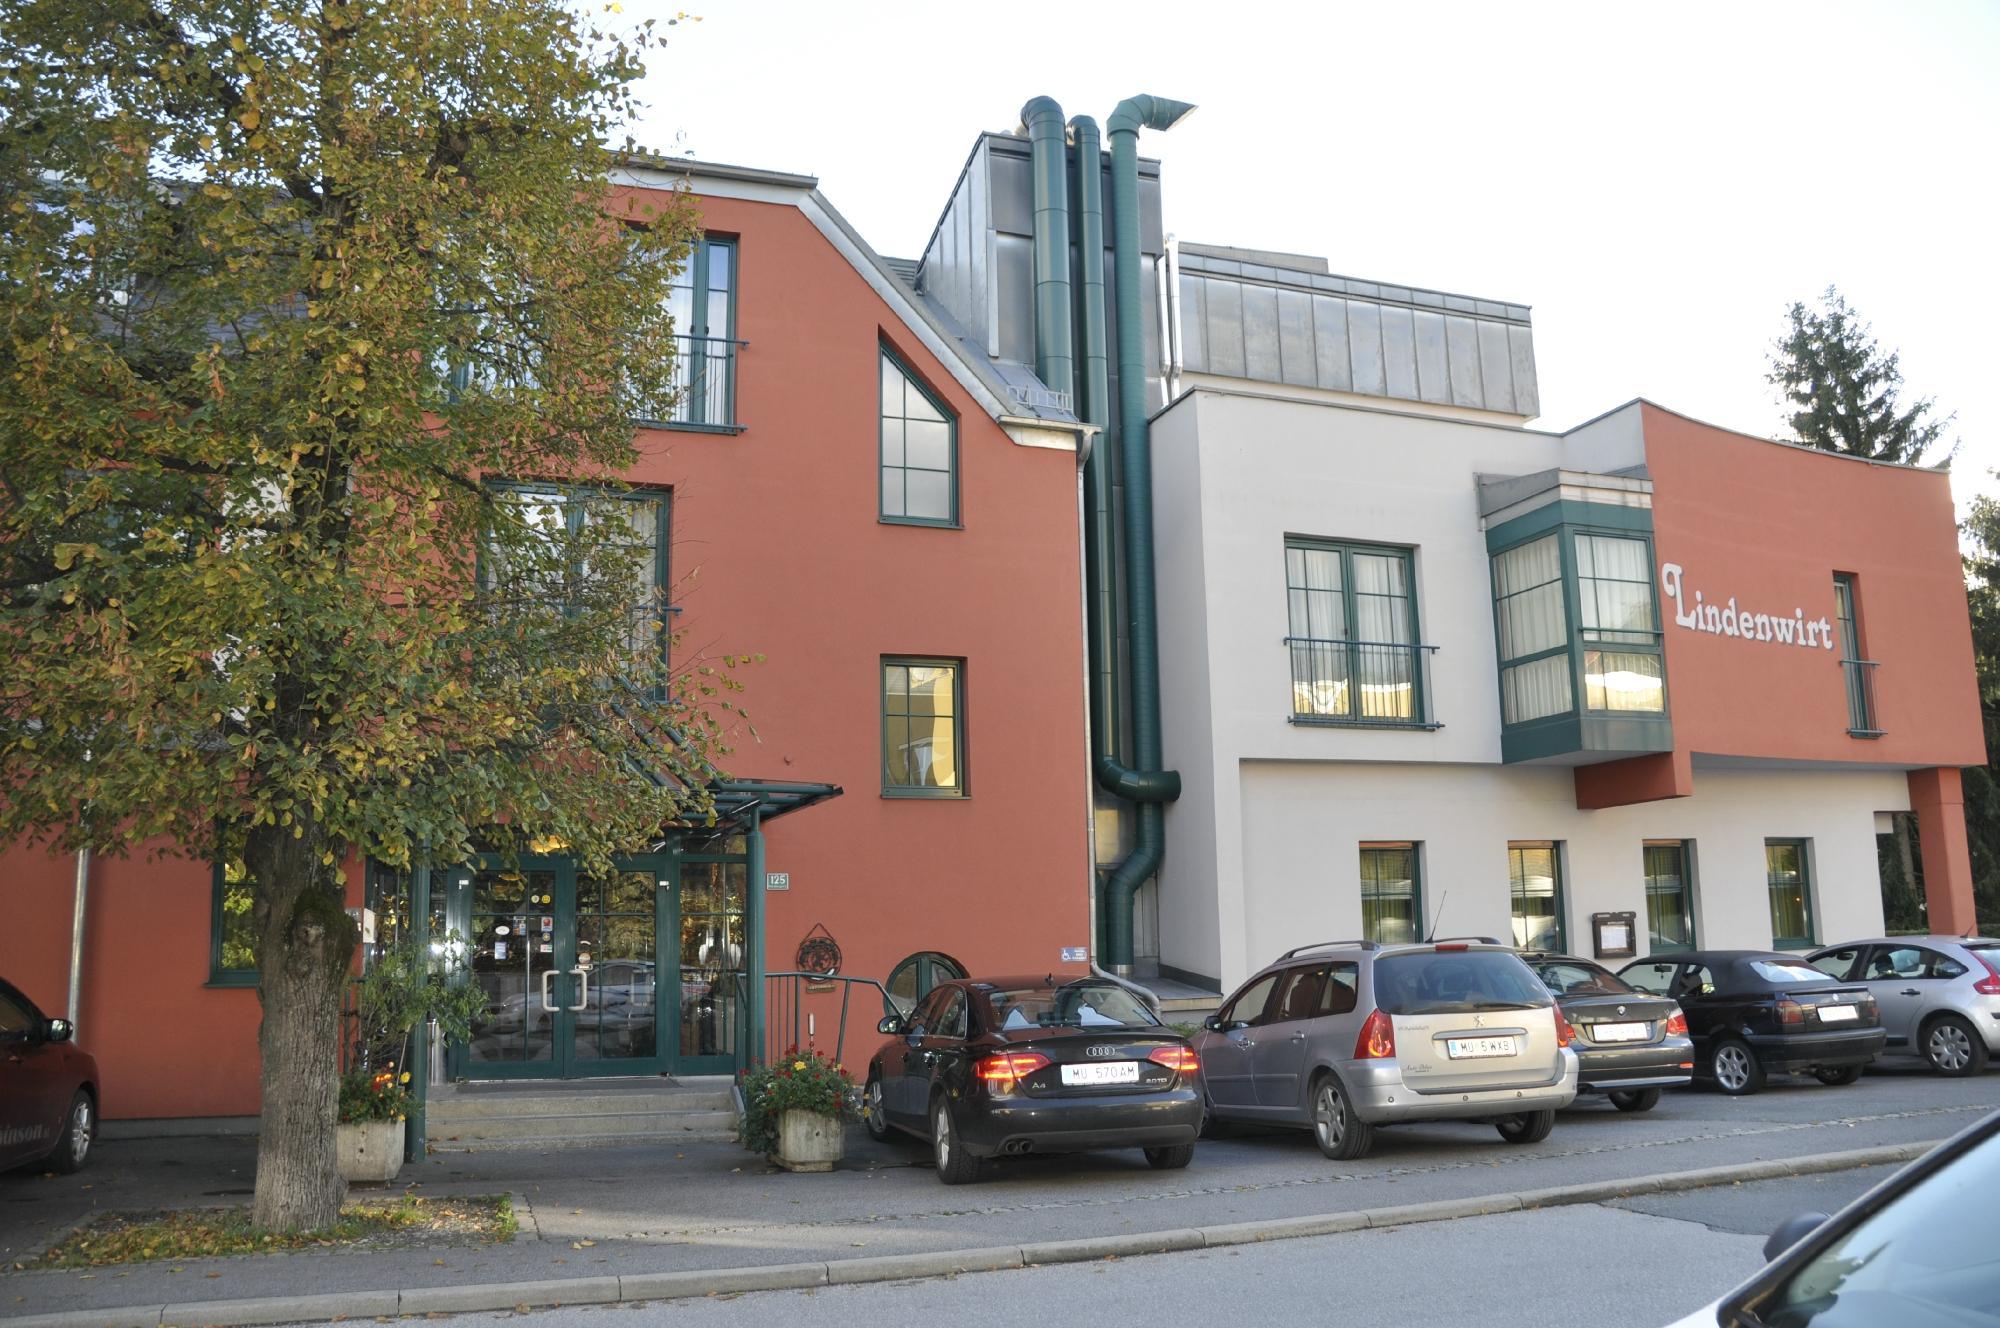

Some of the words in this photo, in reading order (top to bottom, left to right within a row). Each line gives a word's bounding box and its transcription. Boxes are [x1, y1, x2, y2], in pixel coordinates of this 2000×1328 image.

[1661, 562, 1834, 650] Lindenwirt
[770, 875, 786, 885] 125
[1460, 1041, 1474, 1053] MU
[1072, 1067, 1088, 1080] MU
[1031, 1081, 1046, 1089] A4
